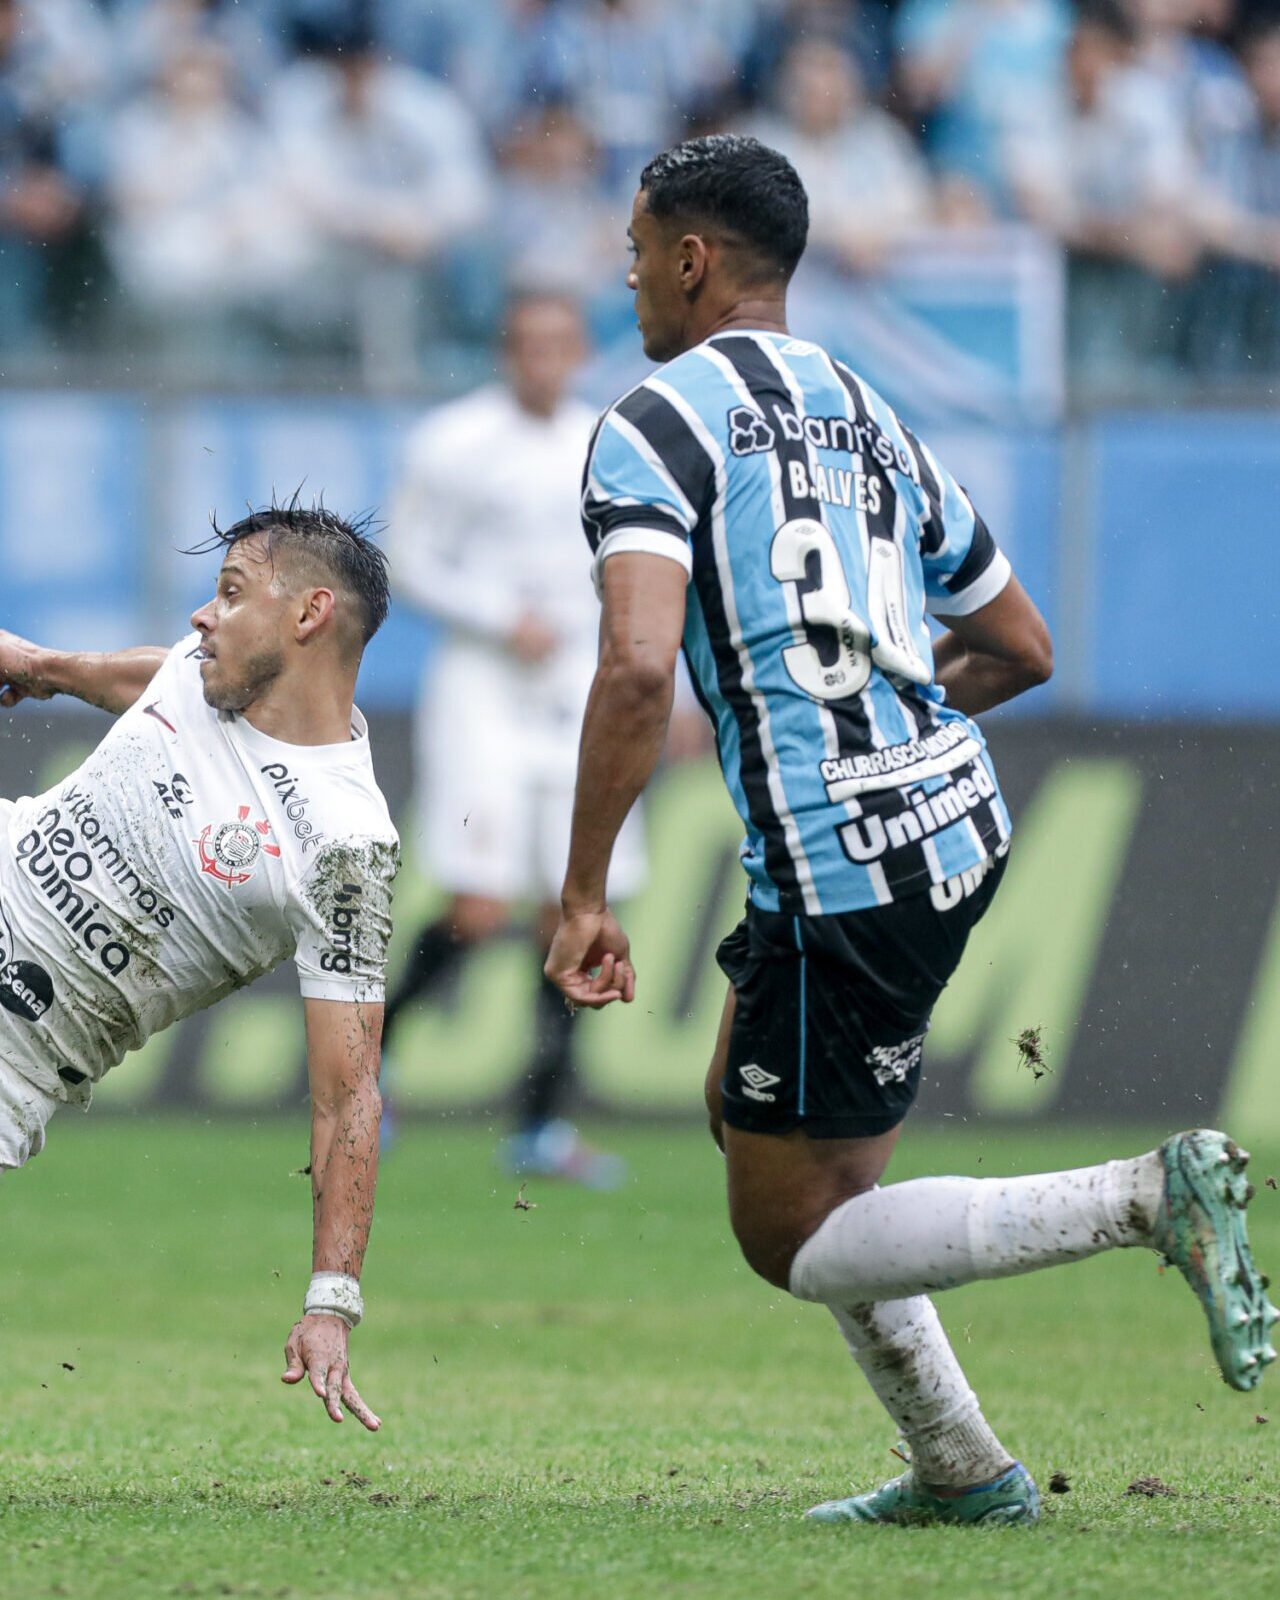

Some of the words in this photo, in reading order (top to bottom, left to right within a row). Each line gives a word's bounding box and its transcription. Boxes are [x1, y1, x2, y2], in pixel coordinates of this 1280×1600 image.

[787, 459, 882, 516] B.ALVES
[152, 779, 184, 820] ALE
[260, 762, 325, 855] pixbet
[840, 756, 996, 861] Unimed
[37, 808, 93, 882] neo
[63, 784, 175, 929] vitaminas
[320, 907, 361, 975] bmg
